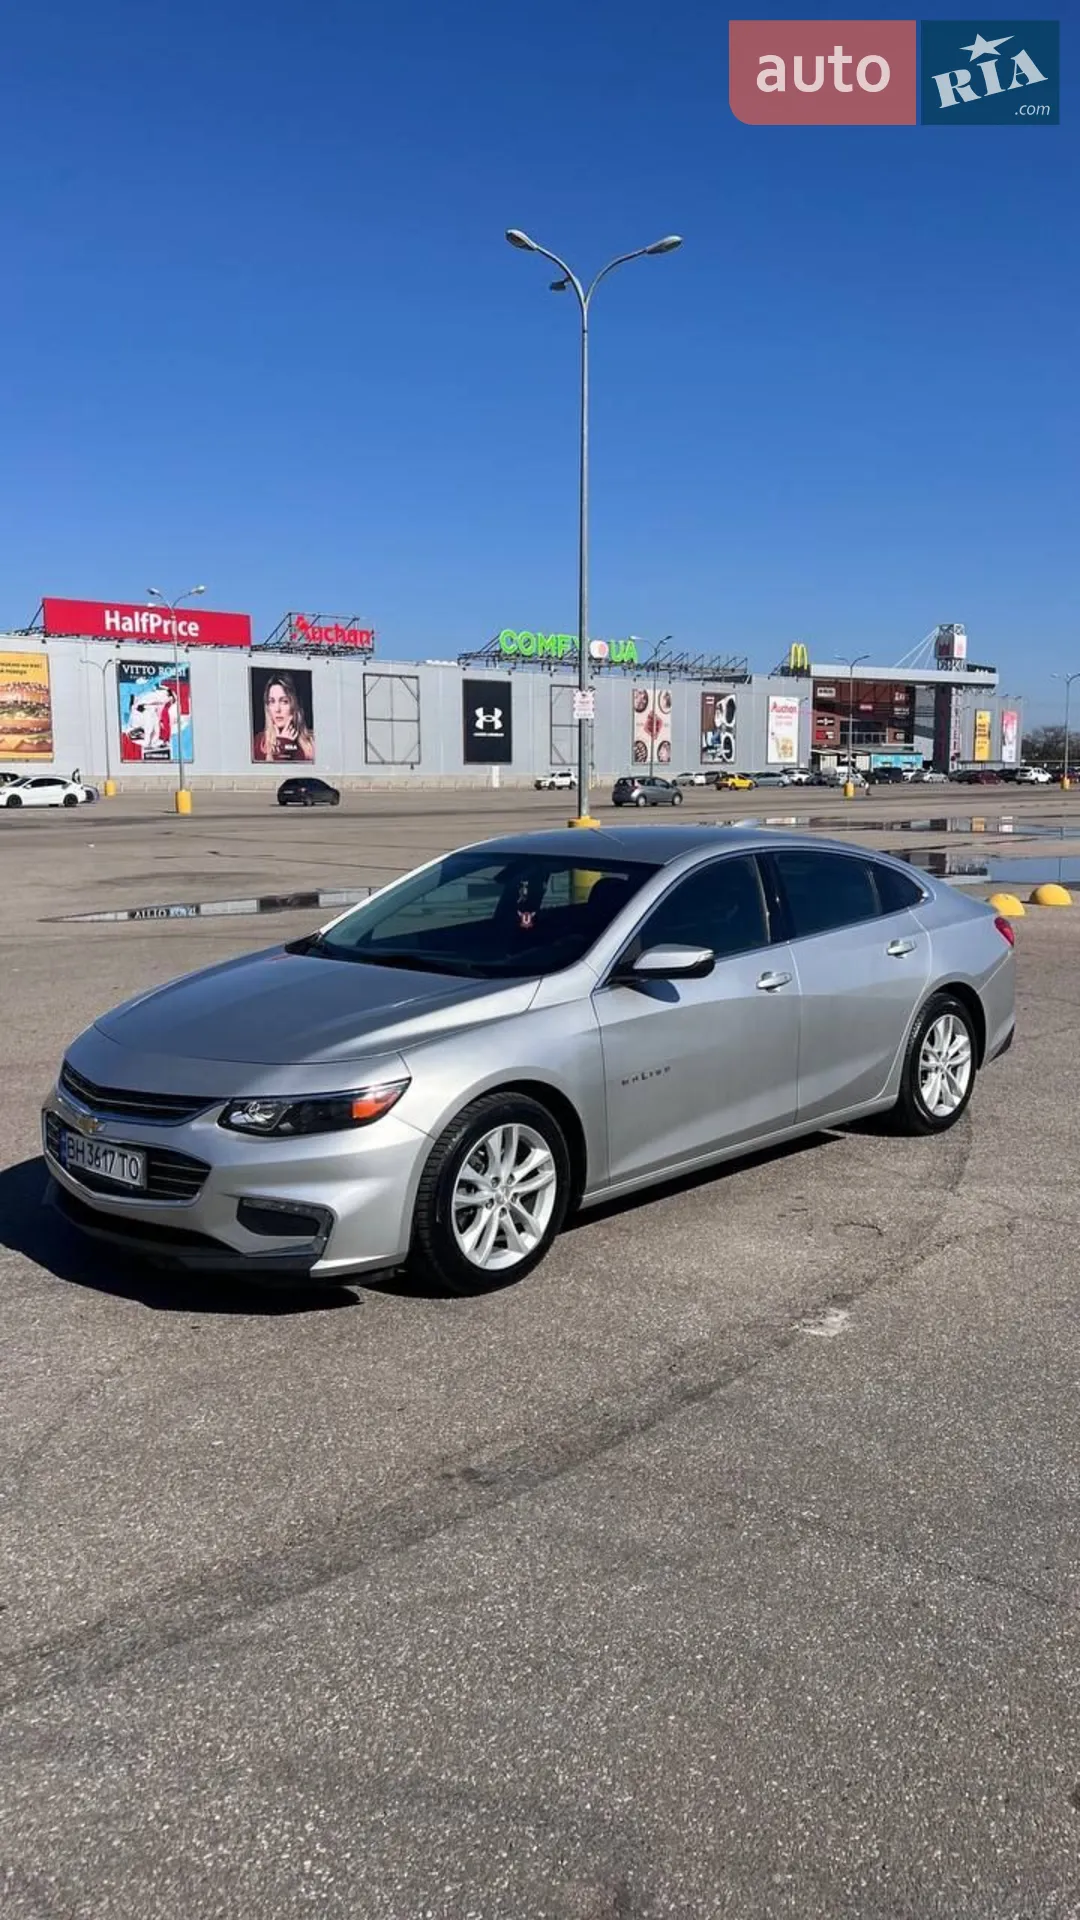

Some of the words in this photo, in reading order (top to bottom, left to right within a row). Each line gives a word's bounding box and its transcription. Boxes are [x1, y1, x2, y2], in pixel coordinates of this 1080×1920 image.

[104, 609, 200, 637] HalfPrice
[290, 615, 371, 646] Auchan
[122, 664, 156, 675] VITTO
[67, 1137, 85, 1164] BH
[87, 1143, 115, 1174] 3617
[119, 1154, 139, 1180] TO
